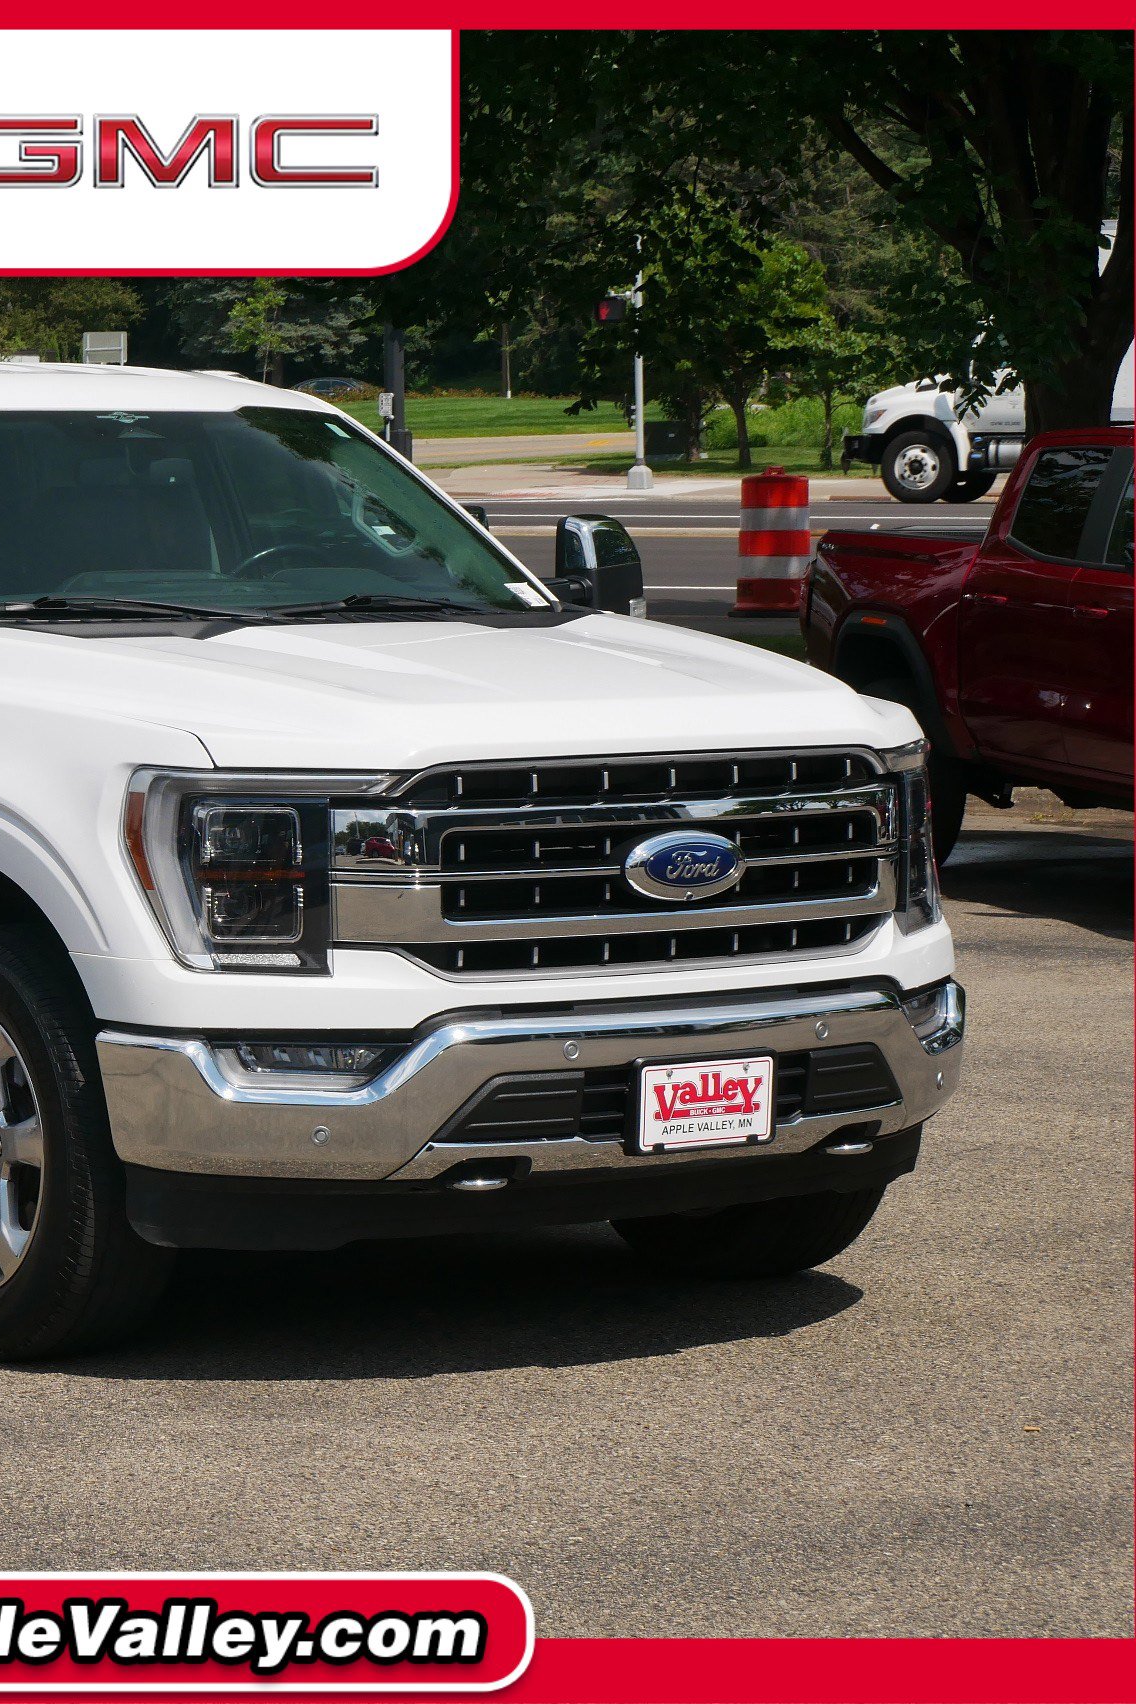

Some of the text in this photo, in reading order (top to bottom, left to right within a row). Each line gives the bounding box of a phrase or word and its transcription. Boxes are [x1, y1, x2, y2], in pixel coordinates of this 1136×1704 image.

[665, 850, 722, 880] Ford
[689, 1105, 726, 1116] BUICK GMC
[661, 1117, 753, 1135] APPLE VALLEY, MN
